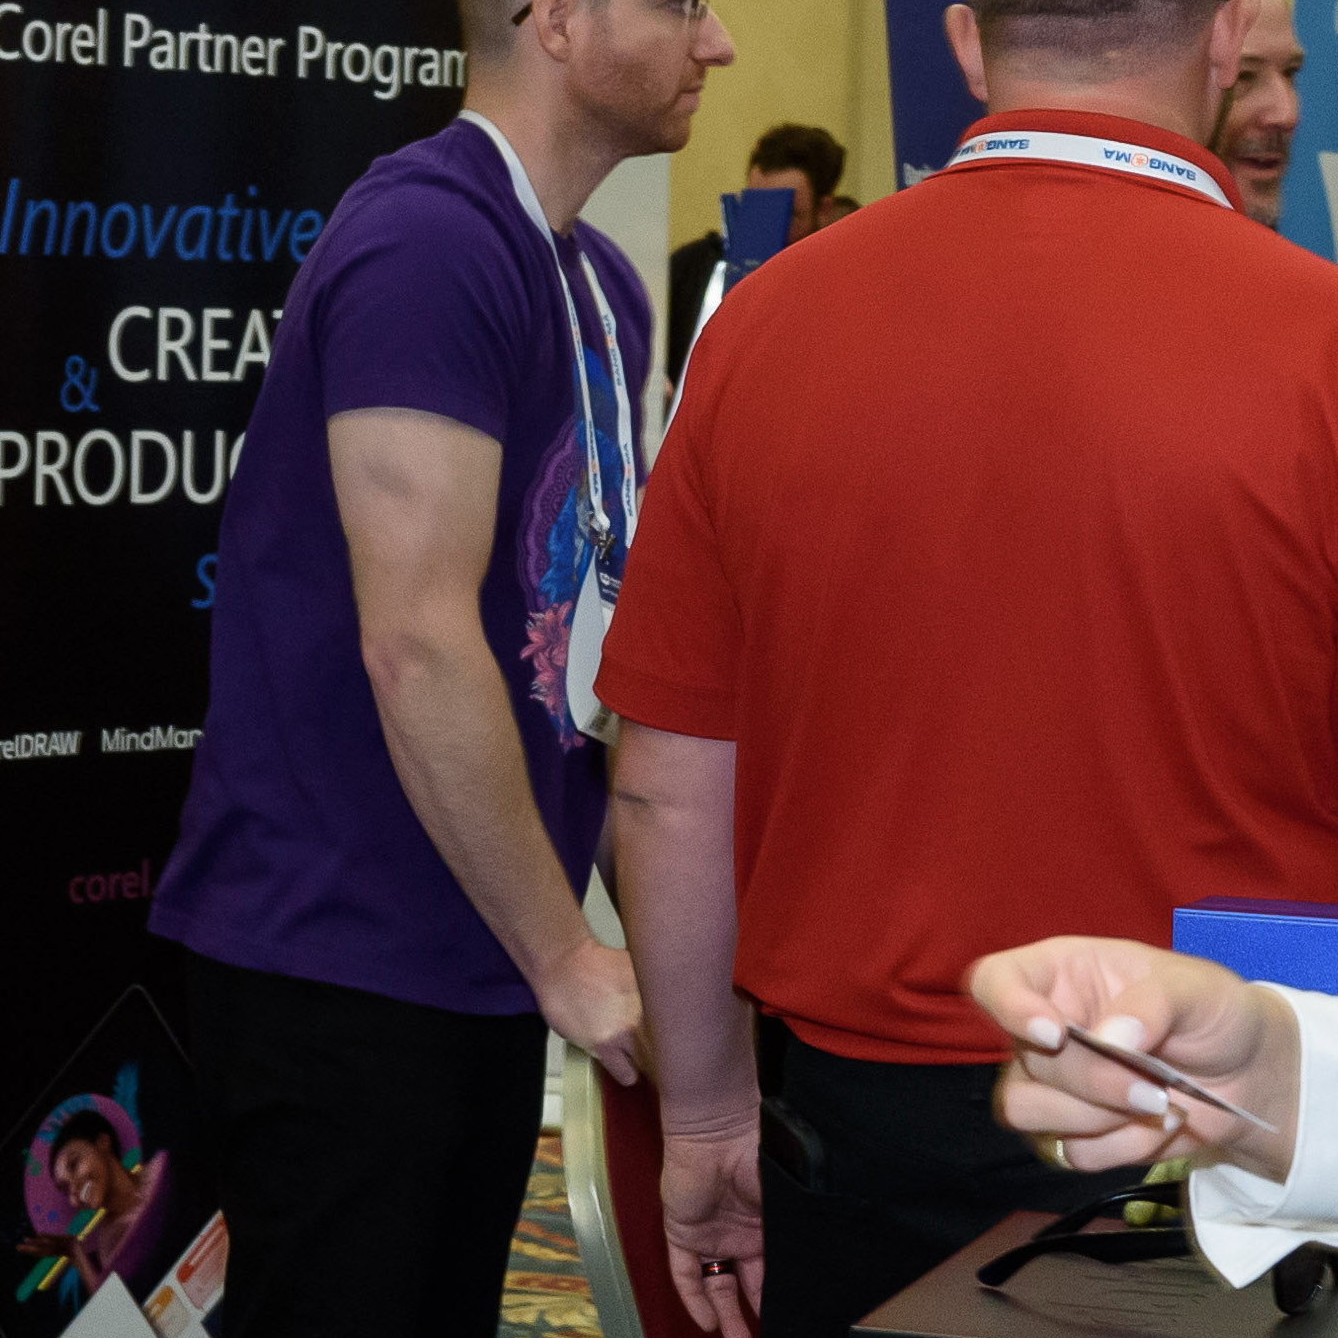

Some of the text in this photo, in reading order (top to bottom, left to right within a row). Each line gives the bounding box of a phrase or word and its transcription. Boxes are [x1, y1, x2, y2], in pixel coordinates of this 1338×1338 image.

[123, 12, 286, 78] Partner
[1103, 147, 1197, 182] SANGOMA
[108, 305, 286, 382] CREA
[60, 355, 100, 412] &
